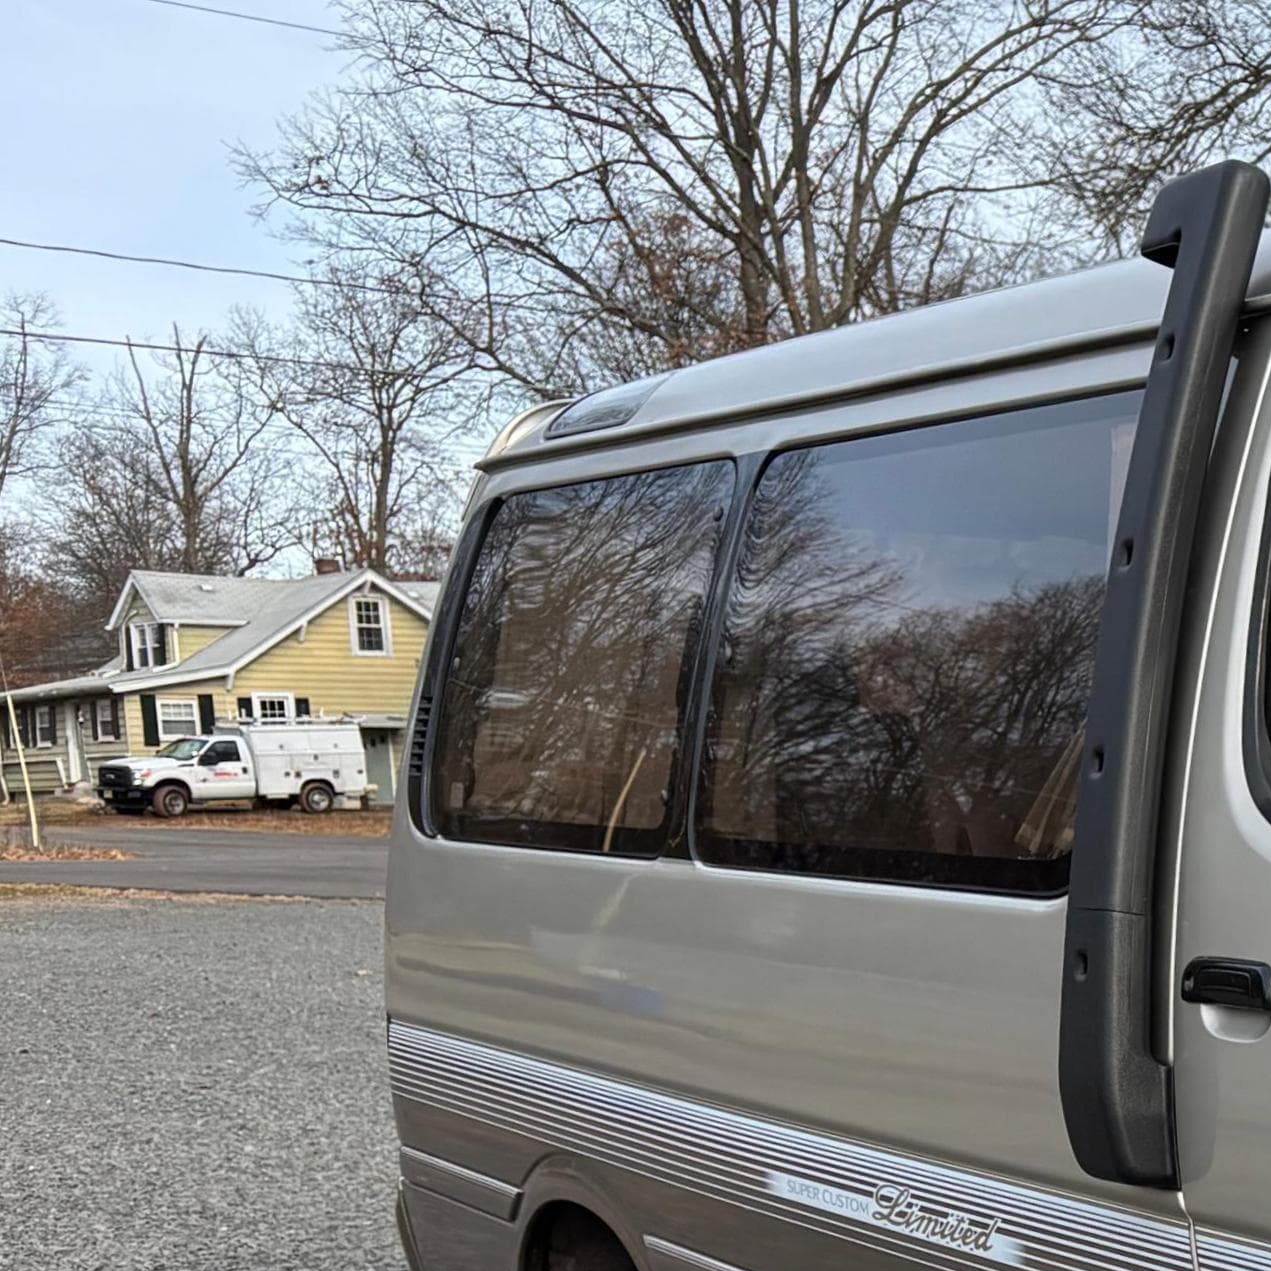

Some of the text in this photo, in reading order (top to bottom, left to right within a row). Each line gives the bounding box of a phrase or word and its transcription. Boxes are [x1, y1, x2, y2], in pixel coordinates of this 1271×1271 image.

[786, 1179, 998, 1252] SUPER CUSTOM Limited
